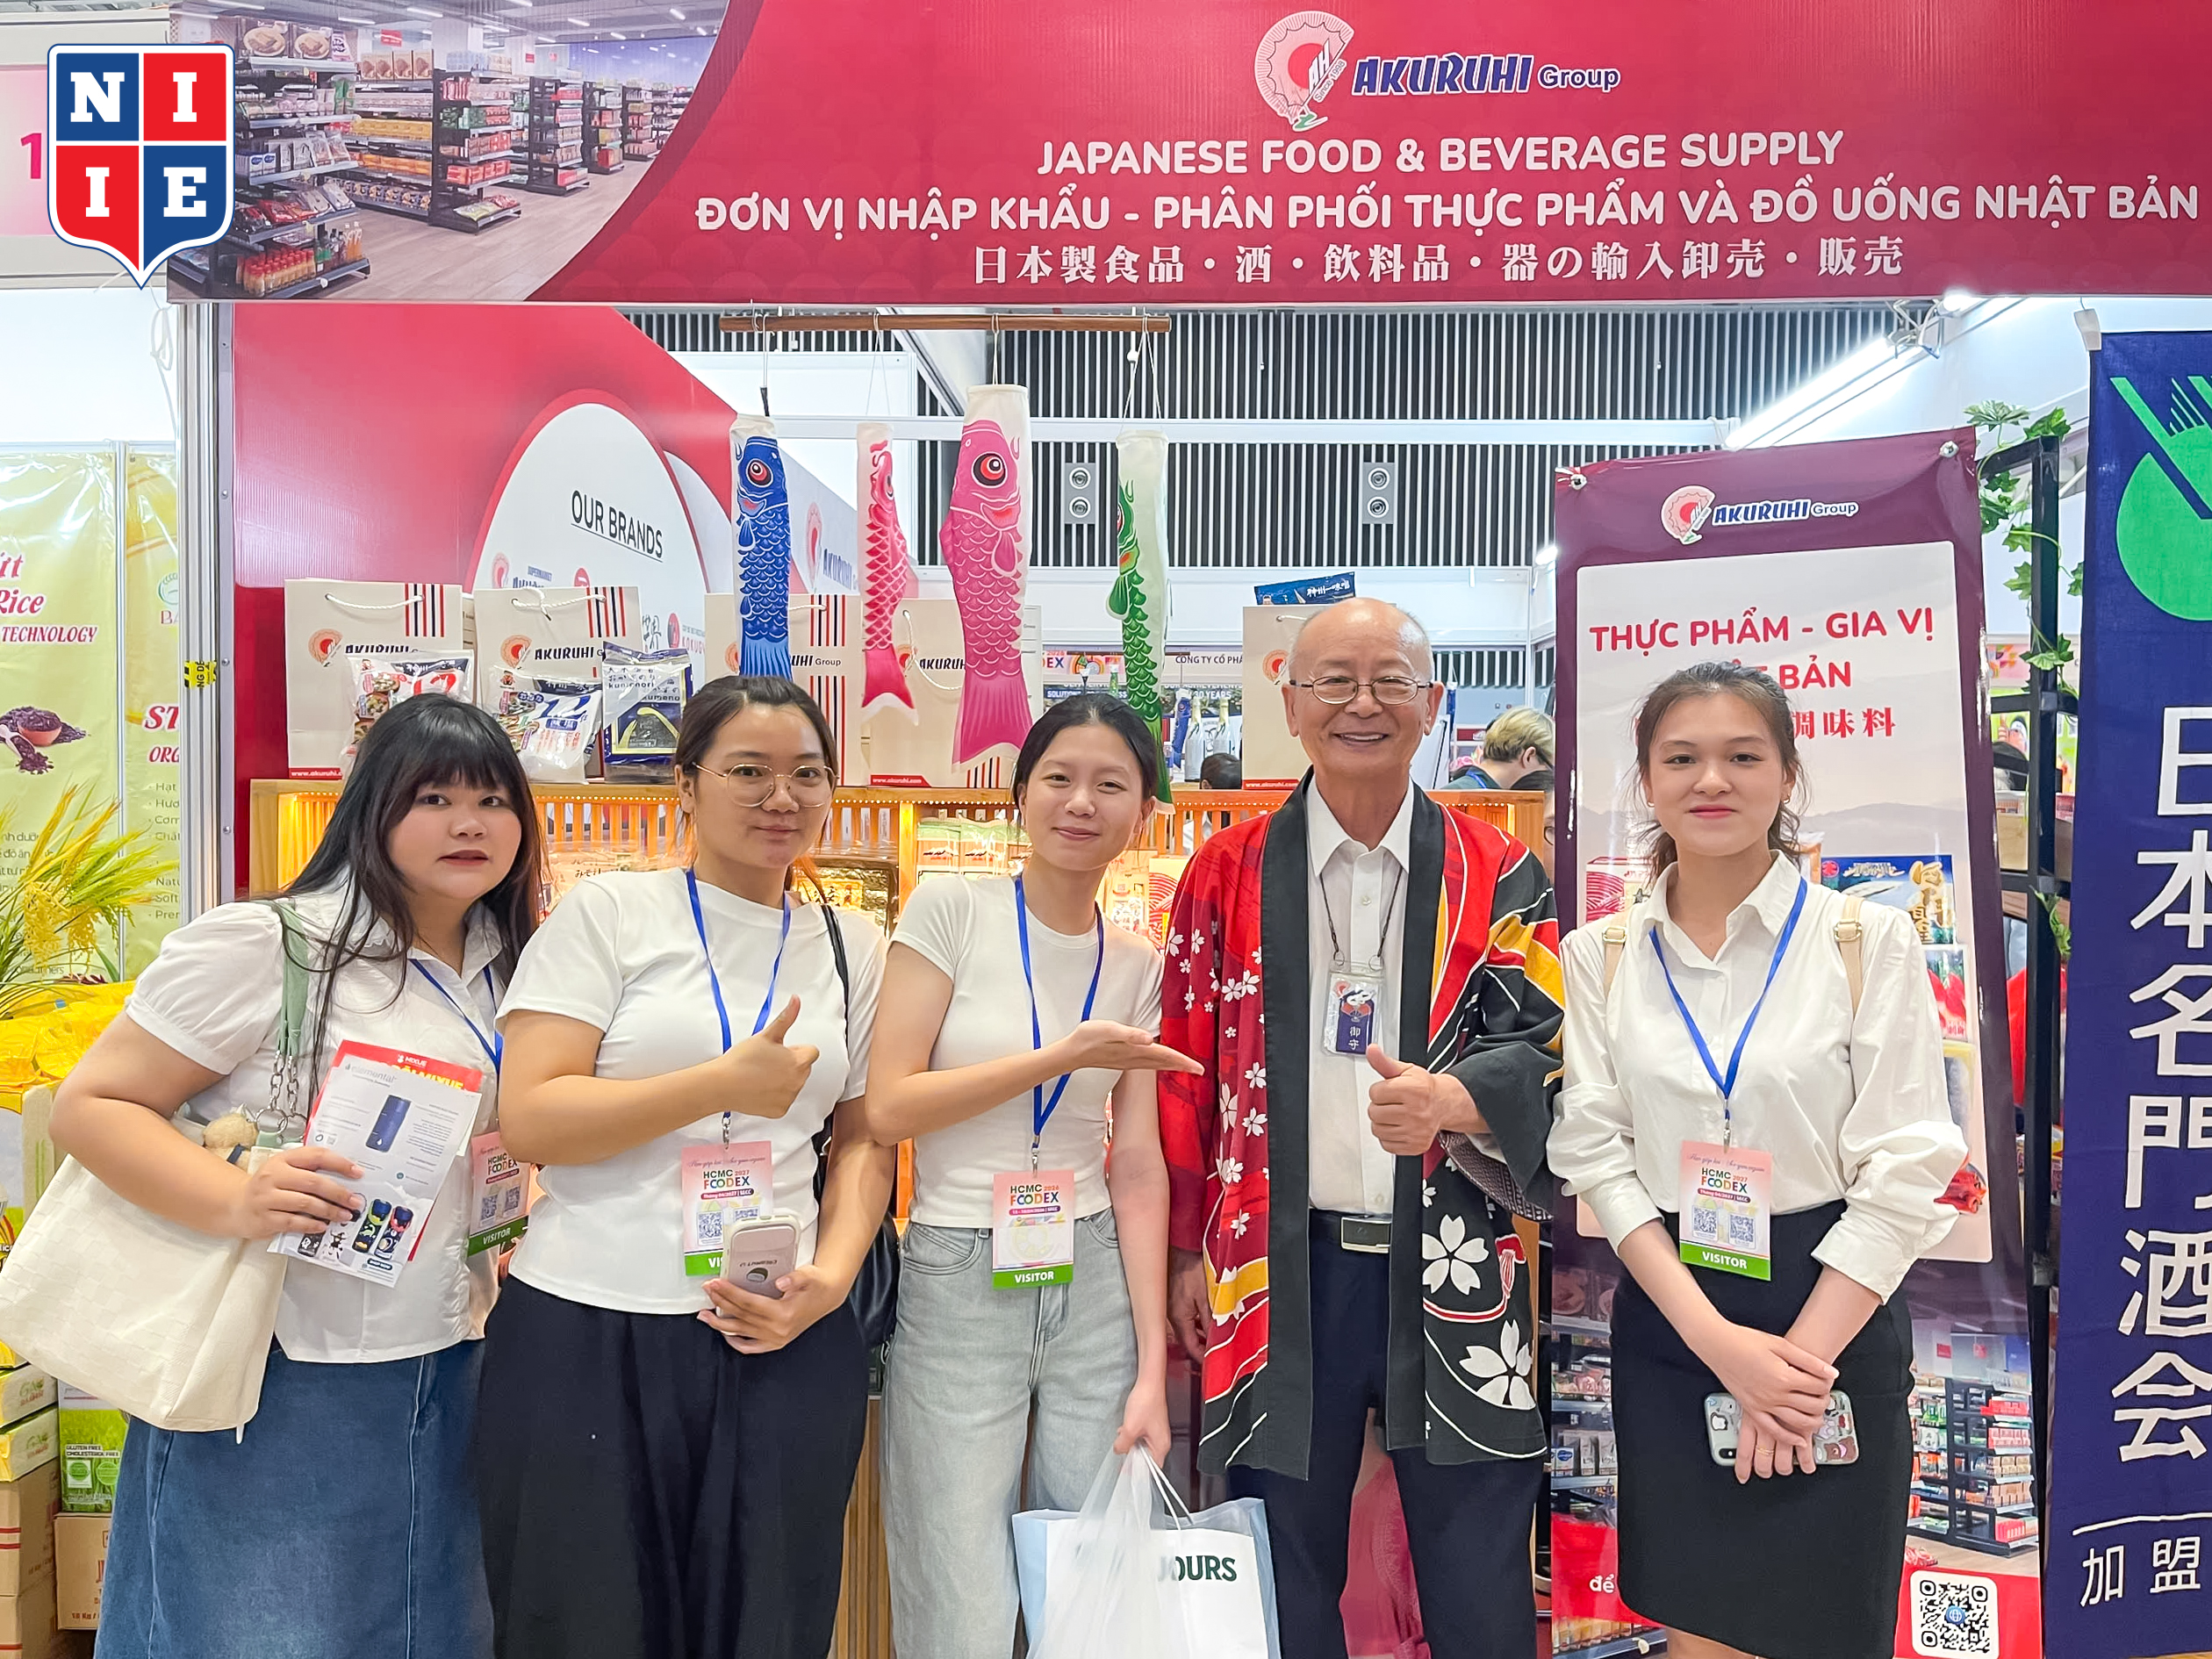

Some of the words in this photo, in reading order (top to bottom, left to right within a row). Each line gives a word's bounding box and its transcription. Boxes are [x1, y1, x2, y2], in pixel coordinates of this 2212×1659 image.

[1354, 55, 1533, 94] AKURUHI
[1540, 67, 1619, 90] Group
[1038, 140, 1247, 175] JAPANESE
[1262, 138, 1382, 174] FOOD
[1397, 138, 1426, 173] &
[1440, 134, 1666, 172] BEVERAGE
[1681, 130, 1843, 168] SUPPLY
[695, 191, 789, 232] ĐƠN
[802, 198, 844, 240] VỊ
[859, 187, 976, 241] NHẬP
[991, 183, 1110, 230] KHẨU
[1155, 185, 1273, 229] PHÂN
[1289, 181, 1390, 228] PHỐI
[1404, 187, 1522, 237] THỰC
[1538, 178, 1664, 226] PHẨM
[1678, 179, 1738, 224] VÀ
[1750, 174, 1817, 223] ĐỒ
[1834, 173, 1959, 221] UỐNG
[1976, 176, 2095, 229] NHẬT
[2109, 176, 2197, 219] BẢN
[1713, 499, 1810, 524] AKURUHI
[1812, 501, 1857, 517] Group
[571, 490, 604, 535] OUR
[609, 506, 663, 558] BRANDS
[2, 626, 97, 643] TECHNOLOGY
[1590, 620, 1678, 657] THỰC
[1691, 607, 1789, 646] PHẨM
[1826, 611, 1887, 638] GIA
[1898, 607, 1934, 642] VỊ
[535, 646, 594, 660] AKURUHI
[815, 657, 841, 668] Group
[1779, 655, 1851, 689] BẢN
[405, 1056, 427, 1067] MIXUE
[487, 1153, 507, 1165] HCMC
[703, 1169, 733, 1179] HCMC
[1701, 1167, 1731, 1180] HCMC
[1010, 1184, 1043, 1194] HCMC
[483, 1228, 511, 1245] VISITOR
[1702, 1251, 1748, 1269] VISITOR
[1014, 1271, 1054, 1283] VISITOR
[2080, 1536, 2201, 1607] 加盟
